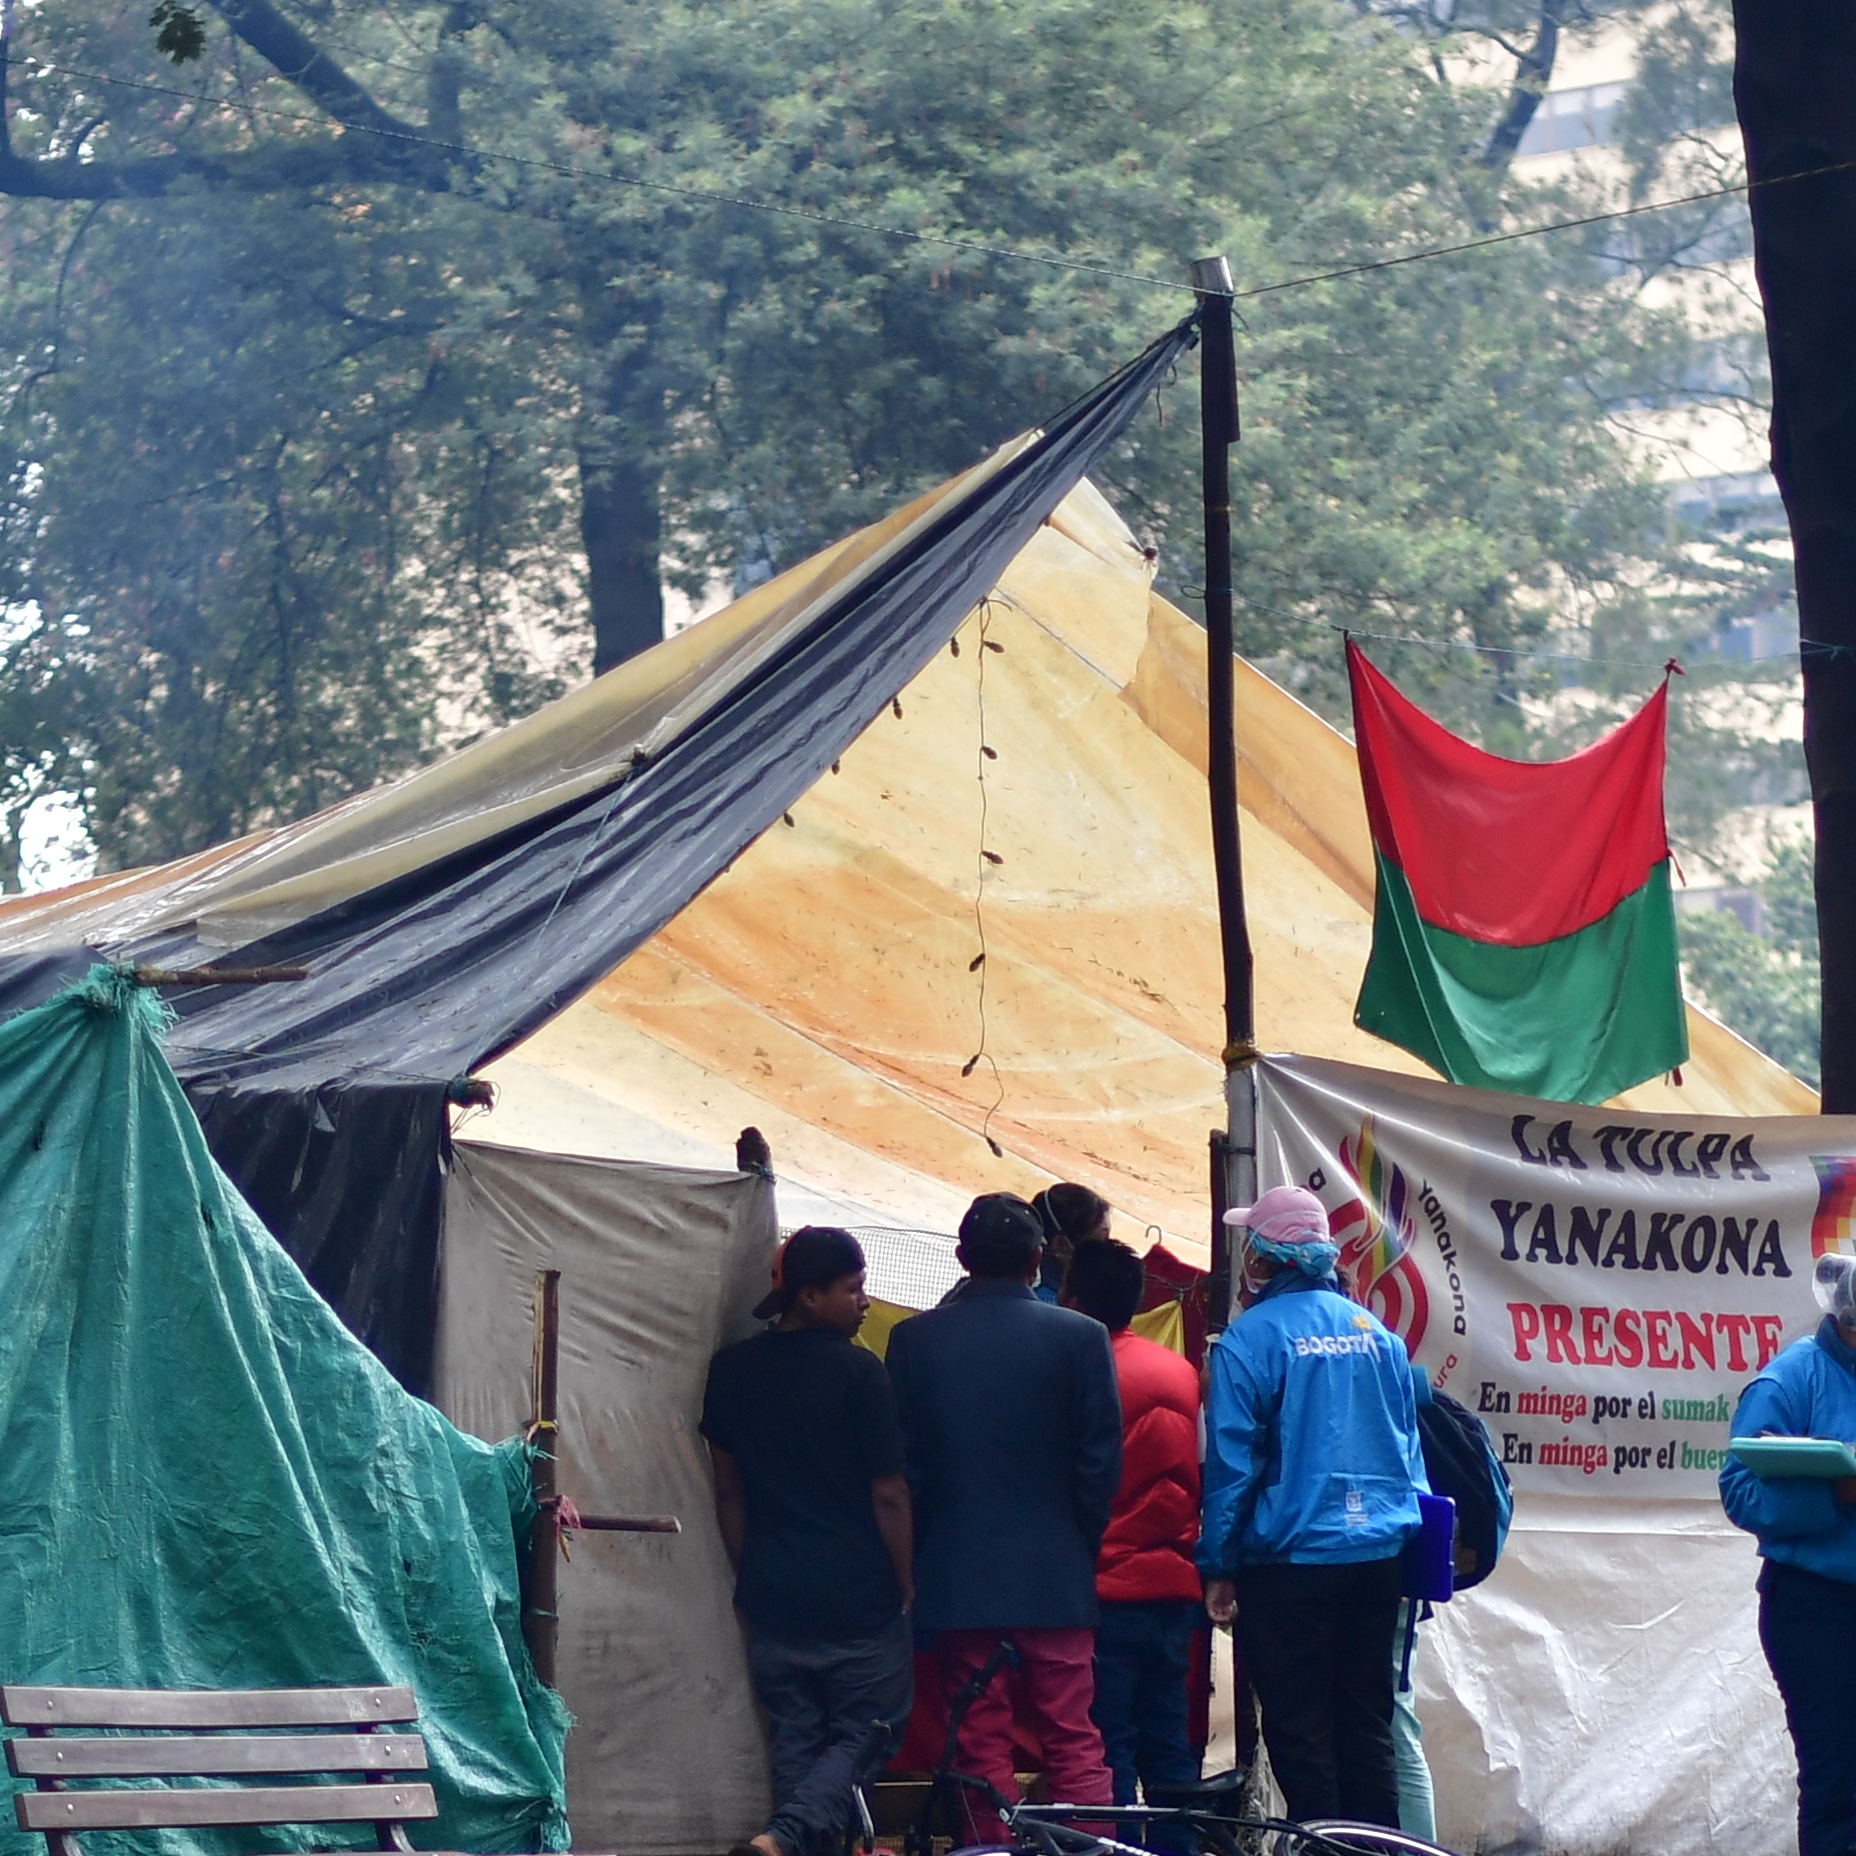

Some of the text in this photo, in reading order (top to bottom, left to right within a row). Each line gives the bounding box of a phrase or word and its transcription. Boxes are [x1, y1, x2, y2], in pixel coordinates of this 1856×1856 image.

[1510, 1114, 1771, 1181] LA TULPA
[1417, 1178, 1467, 1336] Yanakona
[1490, 1199, 1793, 1278] YANAKONA
[1506, 1302, 1784, 1373] PRESENTE
[1477, 1381, 1730, 1424] En minga por el sumak
[1502, 1433, 1533, 1465] En
[1538, 1436, 1608, 1475] minga
[1613, 1446, 1652, 1474] por
[1657, 1440, 1677, 1470] el
